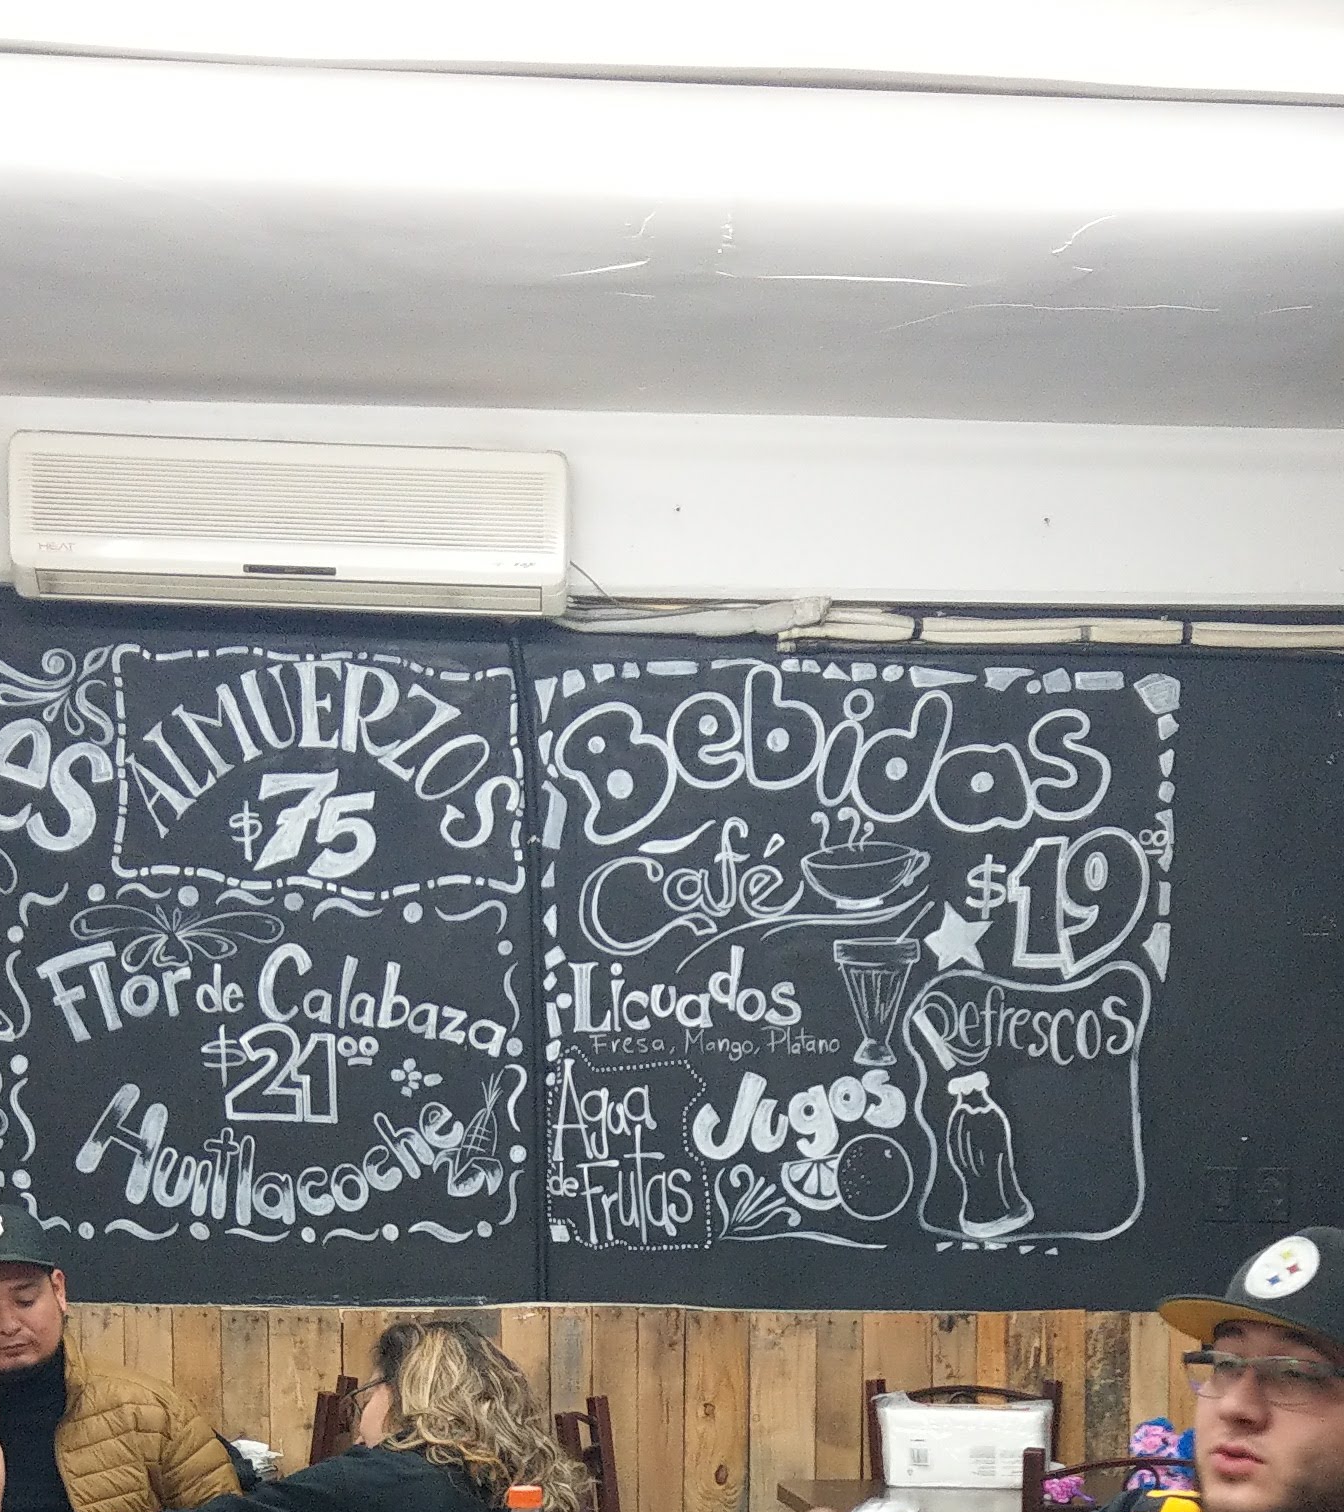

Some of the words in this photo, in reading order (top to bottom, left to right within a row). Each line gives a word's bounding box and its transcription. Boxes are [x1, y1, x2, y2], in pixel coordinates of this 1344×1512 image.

[125, 659, 520, 849] ALMUERZOS
[555, 664, 1111, 845] Bebidas
[230, 768, 376, 878] $75
[579, 817, 804, 956] Café
[37, 942, 193, 1042] Flor
[197, 963, 245, 1014] de
[257, 943, 507, 1058] Calabaza
[570, 946, 803, 1034] Licuados
[762, 1026, 841, 1057] Platano
[912, 989, 1134, 1070] Refrescos
[555, 1059, 656, 1162] Agua
[693, 1069, 906, 1160] Jugos
[549, 1172, 578, 1198] de
[576, 1126, 694, 1244] Frutas
